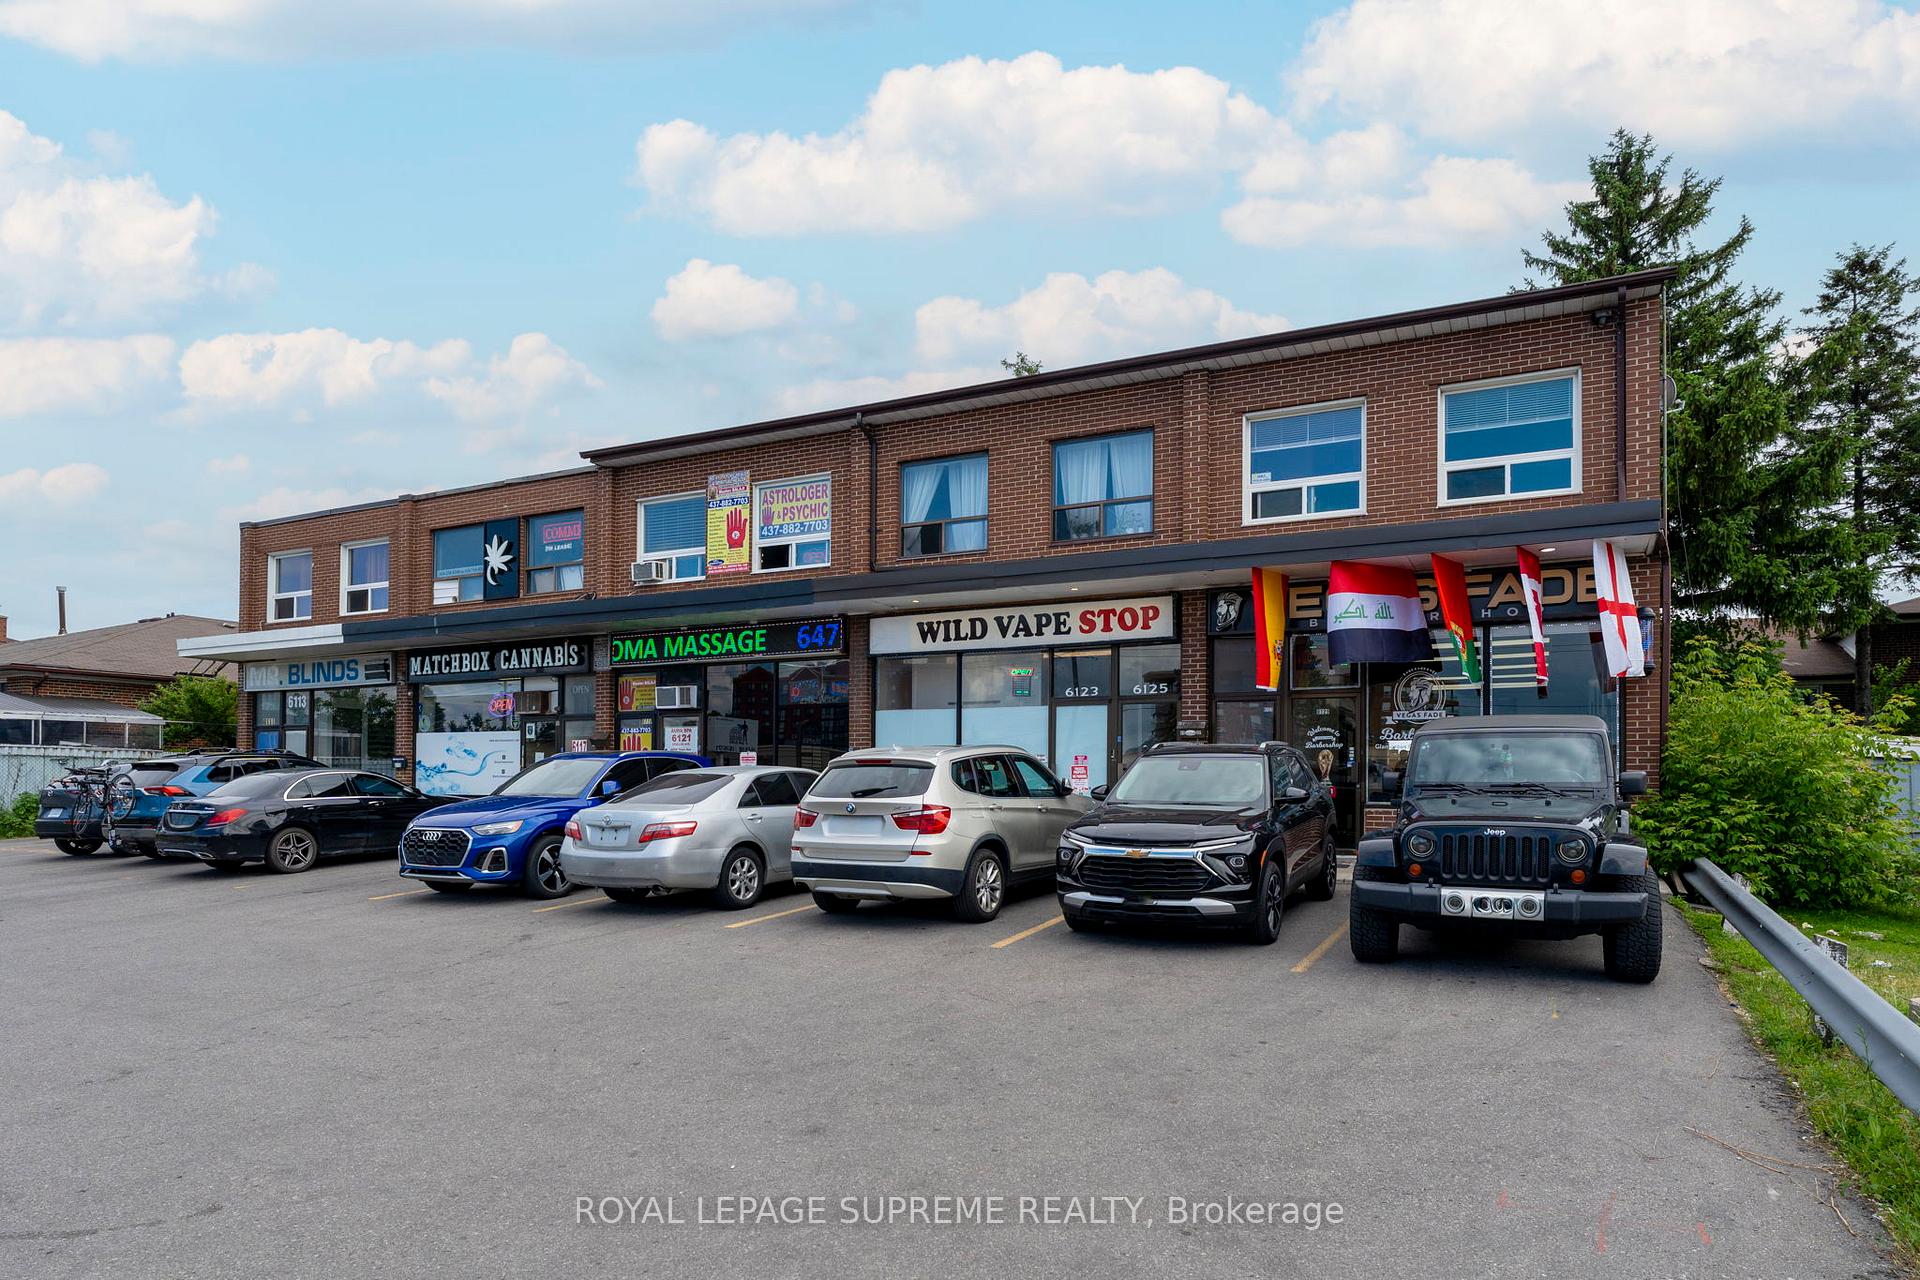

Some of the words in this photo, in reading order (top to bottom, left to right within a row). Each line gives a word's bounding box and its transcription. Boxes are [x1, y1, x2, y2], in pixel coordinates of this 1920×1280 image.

[762, 483, 828, 506] ASTROLOGER
[782, 501, 828, 521] PSYCHIC
[762, 520, 828, 537] 437-882-7703
[916, 616, 988, 644] WILD
[993, 611, 1072, 639] VAPE
[1078, 604, 1161, 634] STOP
[664, 629, 767, 658] MASSAGE
[797, 623, 839, 649] 647
[409, 650, 490, 676] MATCHBOX
[500, 642, 579, 670] CANNABIS
[288, 658, 359, 685] BLINDS
[1011, 668, 1034, 676] OPEN
[1065, 686, 1099, 698] 6123
[1132, 683, 1169, 695] 6125
[288, 695, 307, 709] 6113
[490, 698, 513, 713] OPEN
[671, 733, 692, 742] 6121
[1306, 725, 1335, 737] Welcome
[1304, 740, 1344, 750] Barbershop
[1483, 828, 1506, 836] Jeep
